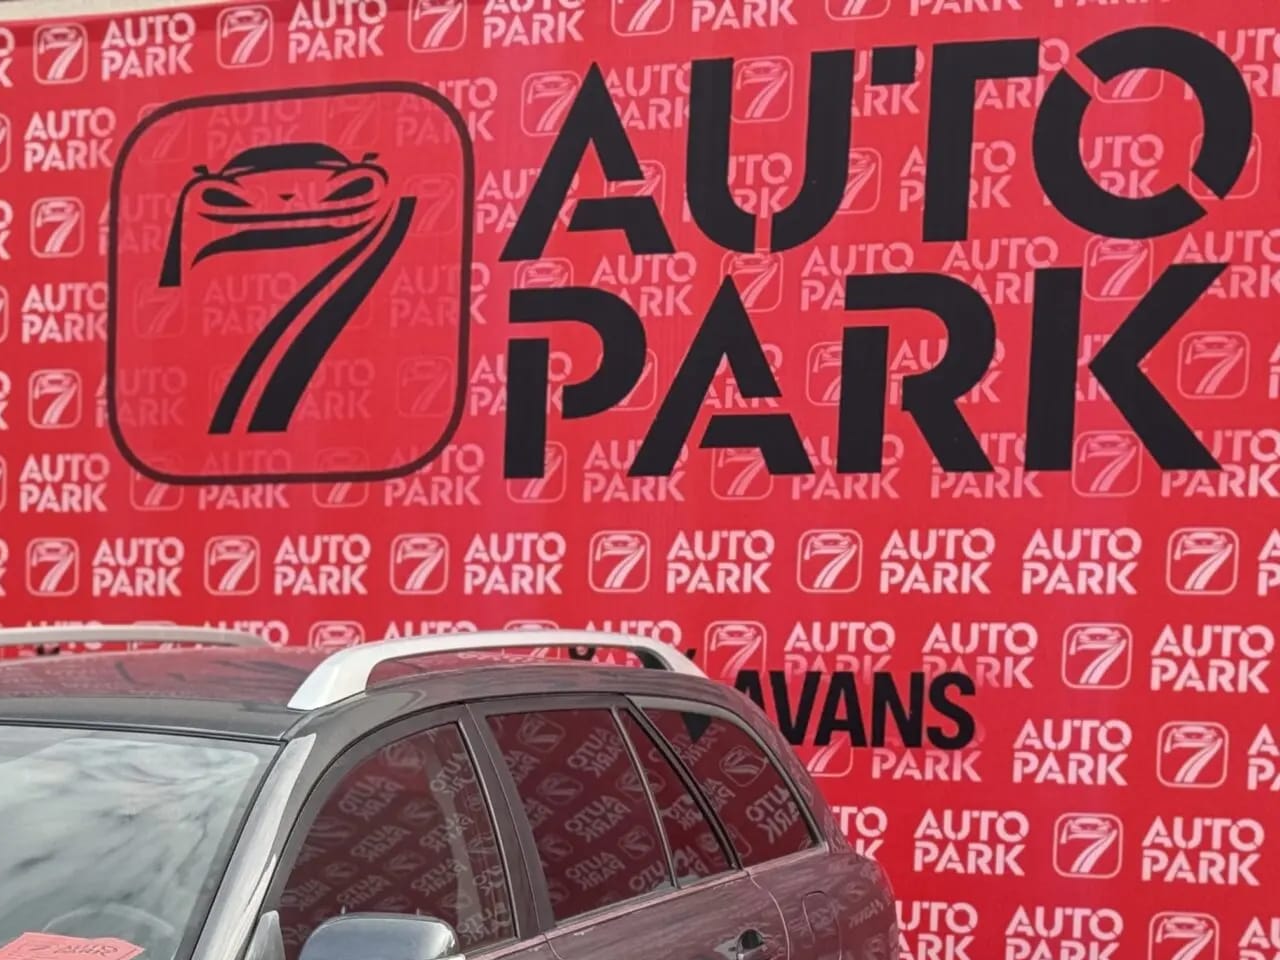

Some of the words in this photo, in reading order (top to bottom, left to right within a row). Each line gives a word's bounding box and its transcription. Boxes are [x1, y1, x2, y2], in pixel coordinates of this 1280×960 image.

[102, 13, 195, 50] AUTO
[288, 0, 387, 31] AUTO
[483, 11, 585, 48] PARK
[691, 0, 798, 32] PARK
[289, 26, 385, 63] PARK
[102, 43, 192, 80] PARK
[24, 108, 115, 141] AUTO
[25, 139, 112, 172] PARK
[499, 26, 1253, 262] AUTO
[590, 252, 697, 287] AUTO
[801, 243, 914, 276] AUTO
[942, 236, 1059, 271] AUTO
[22, 283, 108, 313] AUTO
[22, 312, 107, 343] PARK
[504, 263, 1228, 479] PARK
[20, 454, 109, 483] AUTO
[792, 468, 900, 500] PARK
[1162, 464, 1280, 498] PARK
[20, 483, 106, 512] PARK
[384, 475, 481, 507] PARK
[583, 470, 685, 503] PARK
[93, 537, 184, 567] AUTO
[275, 534, 370, 564] AUTO
[464, 532, 565, 562] AUTO
[667, 530, 774, 561] AUTO
[881, 528, 995, 560] AUTO
[1023, 528, 1141, 560] AUTO
[93, 566, 181, 596] PARK
[275, 565, 367, 595] PARK
[464, 564, 562, 594] PARK
[667, 562, 771, 593] PARK
[880, 562, 990, 593] PARK
[1022, 562, 1137, 594] PARK
[784, 621, 896, 654] AUTO
[923, 622, 1038, 655] AUTO
[1152, 625, 1274, 658] AUTO
[1151, 658, 1269, 693] PARK
[734, 669, 976, 750] AVANS
[1014, 719, 1132, 752] AUTO
[871, 748, 982, 783] PARK
[1013, 752, 1127, 785] PARK
[914, 810, 1029, 842] AUTO
[1142, 816, 1264, 851] AUTO
[914, 841, 1024, 875] PARK
[1142, 849, 1260, 885] PARK
[1006, 906, 1123, 940] AUTO
